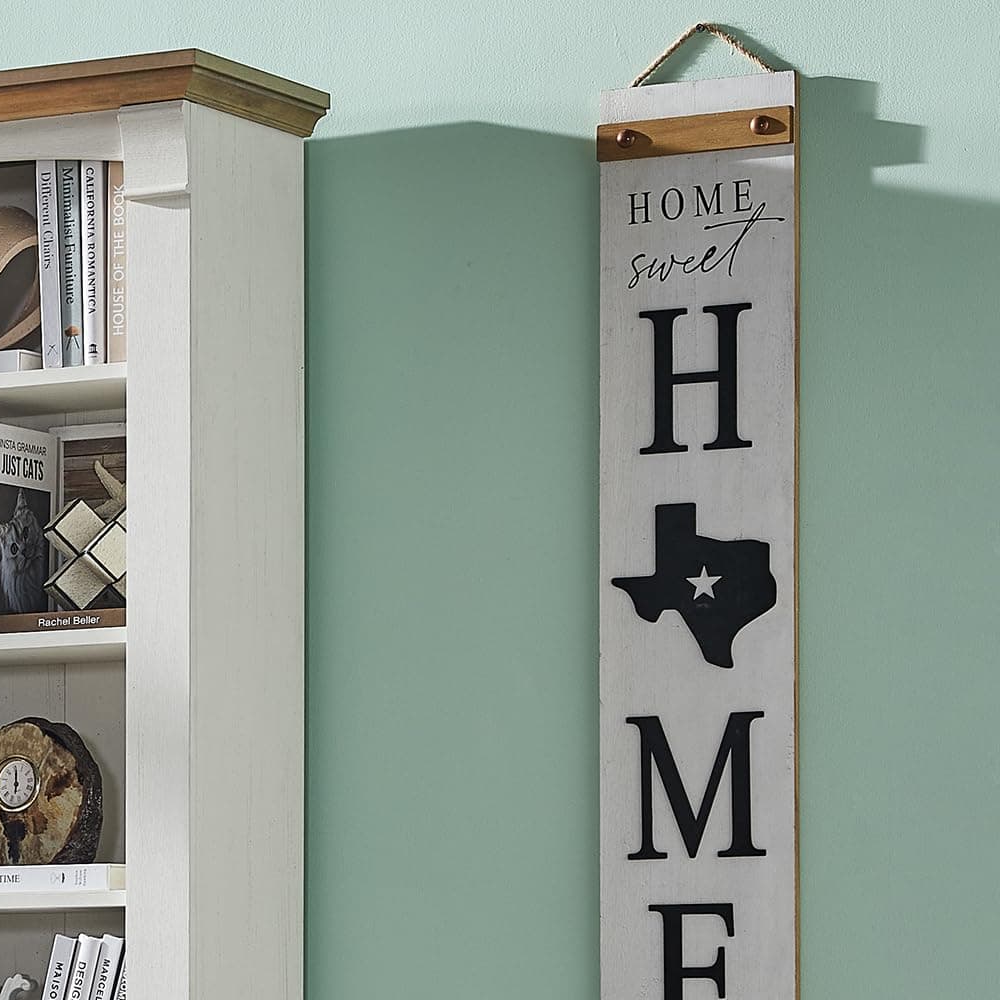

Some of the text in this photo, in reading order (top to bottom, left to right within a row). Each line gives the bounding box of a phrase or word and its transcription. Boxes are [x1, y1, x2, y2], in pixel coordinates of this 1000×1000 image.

[41, 171, 54, 270] Different Chairs
[62, 166, 77, 305] Minimalist Furniture
[628, 178, 753, 226] HOME
[85, 166, 97, 314] CALIFORNIA ROMANTICA
[112, 184, 125, 336] HOUSE OF THE BOOK
[627, 201, 786, 289] sweet
[0, 439, 47, 457] INSTA GRAMMAR
[1, 453, 44, 481] JUST CATS
[38, 615, 100, 627] Rachel Beller
[0, 874, 20, 884] TIME
